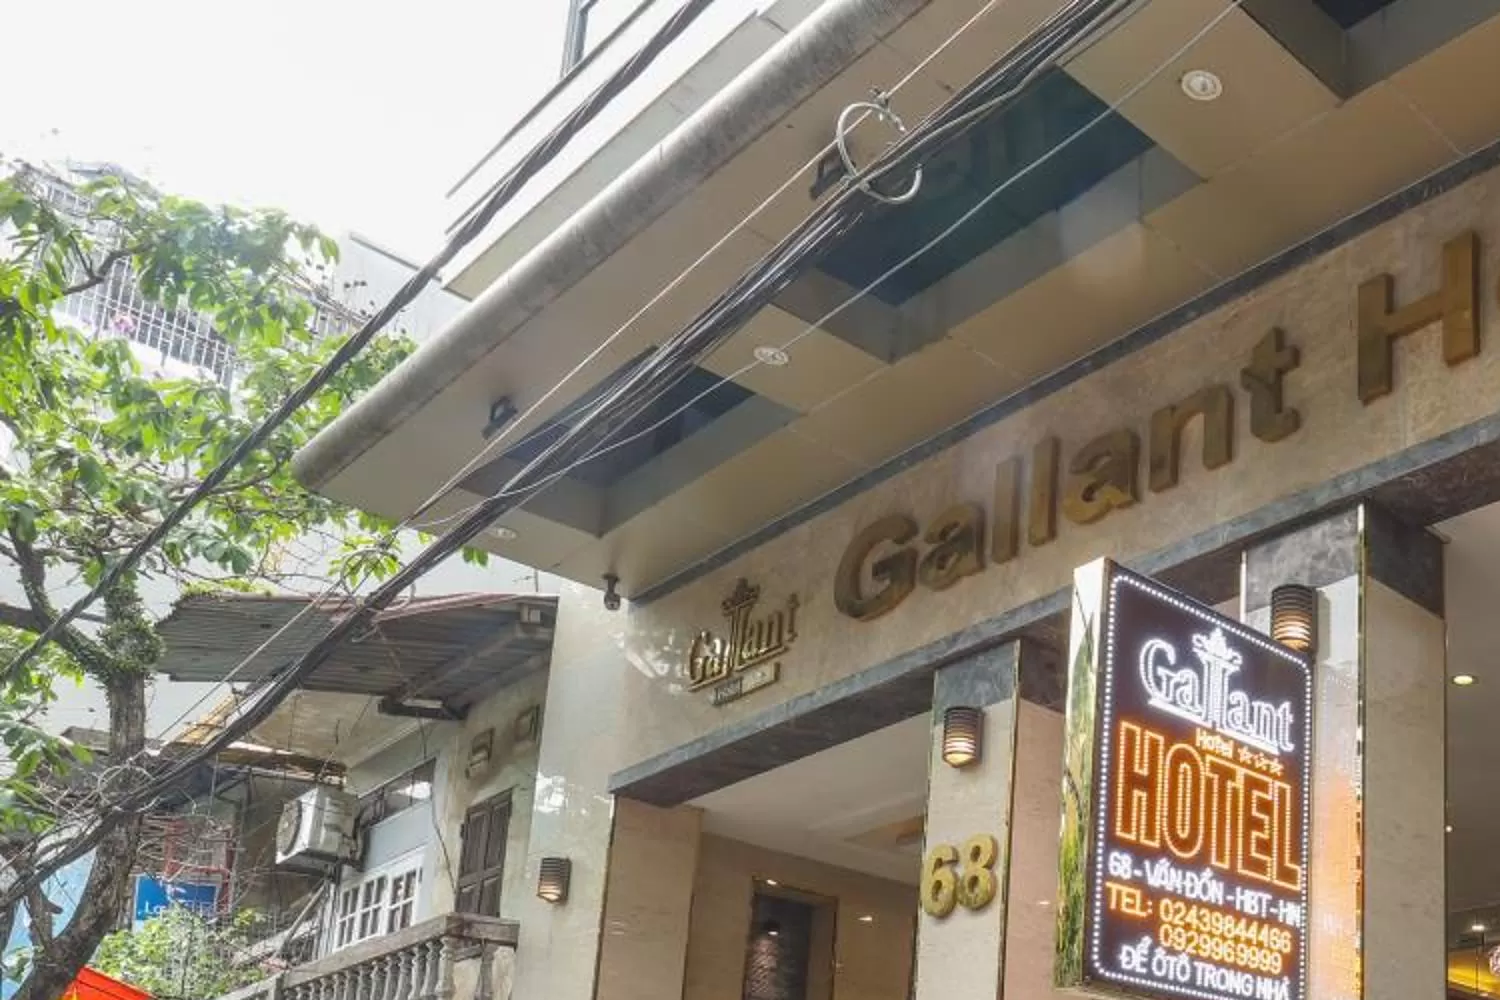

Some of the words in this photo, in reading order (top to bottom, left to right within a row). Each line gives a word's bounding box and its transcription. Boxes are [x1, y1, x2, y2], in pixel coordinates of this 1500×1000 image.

[834, 326, 1300, 622] Gallant
[1139, 637, 1295, 751] Gallant
[1116, 721, 1301, 891] HOTEL
[921, 833, 998, 917] 68
[1108, 851, 1133, 880] 68
[1235, 886, 1272, 918] HBT
[1106, 881, 1153, 917] TEL:
[1159, 898, 1292, 953] 02439844466
[1159, 923, 1283, 975] 0929969999
[1194, 961, 1254, 997] TRONG
